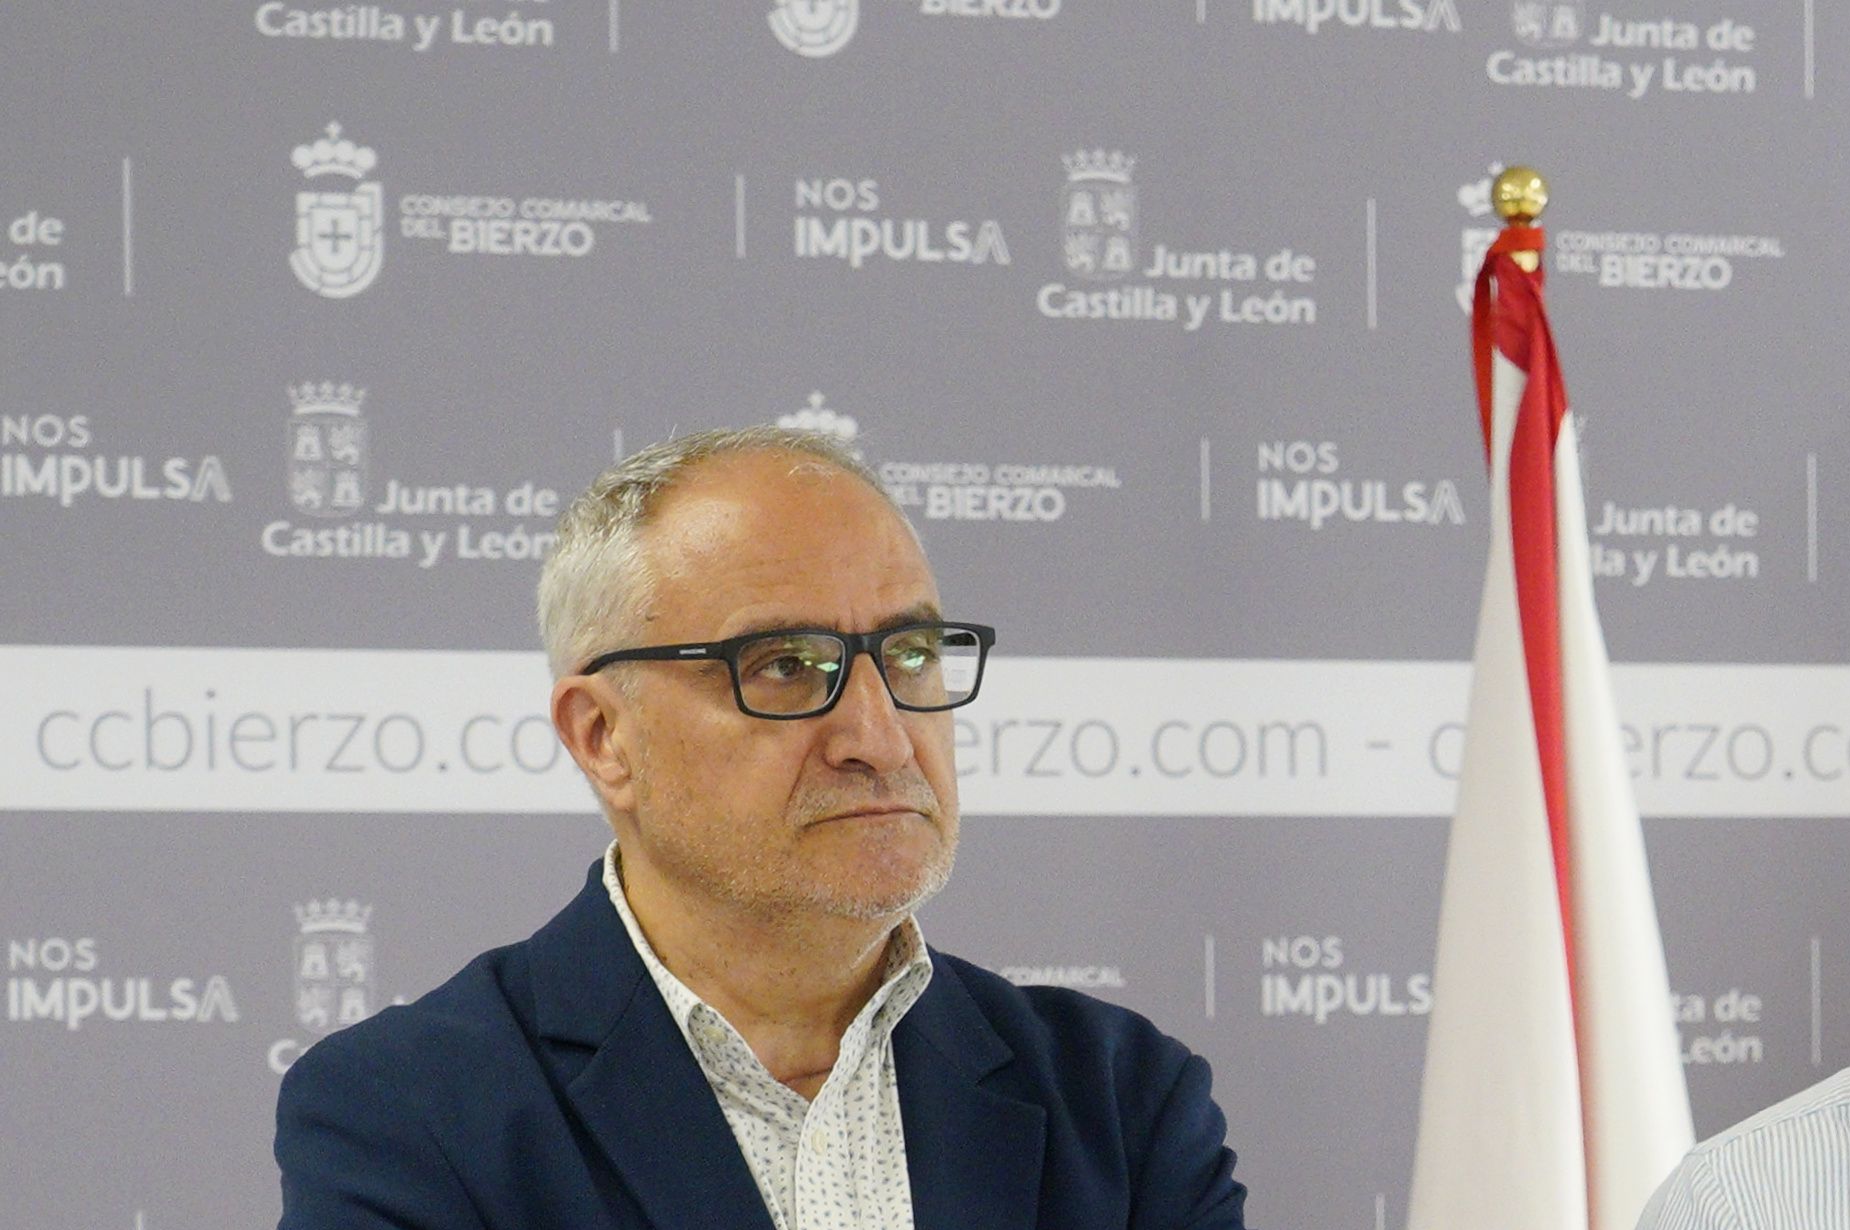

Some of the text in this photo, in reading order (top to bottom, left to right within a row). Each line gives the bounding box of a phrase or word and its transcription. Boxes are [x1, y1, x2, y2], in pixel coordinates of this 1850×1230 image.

[256, 2, 555, 52] Castilla y León
[1592, 15, 1756, 53] Junta de
[1487, 52, 1757, 100] Castilla y León
[401, 196, 652, 223] CONSEJO COMARCAL
[796, 179, 880, 212] NOS
[10, 212, 65, 246] de
[401, 215, 596, 258] DEL BIERZO
[1558, 233, 1783, 260] CONSEJO COMARCAL
[1146, 246, 1316, 283] Junta de
[1557, 253, 1732, 291] DEL BIERZO
[1038, 284, 1317, 332] Castilla y León
[3, 415, 92, 449] NOS
[1259, 442, 1340, 475] NOS
[995, 466, 1121, 488] COMARCAL
[378, 481, 559, 517] Junta de
[927, 488, 1068, 522] BIERZO
[1596, 504, 1759, 538] Junta de
[262, 522, 405, 558] Castilla
[416, 533, 440, 569] y
[1635, 553, 1658, 587] y
[1667, 546, 1759, 579] León
[37, 687, 562, 776] ccbierzo.co
[10, 938, 98, 972] NOS
[1264, 937, 1344, 969] NOS
[1714, 990, 1762, 1023] de
